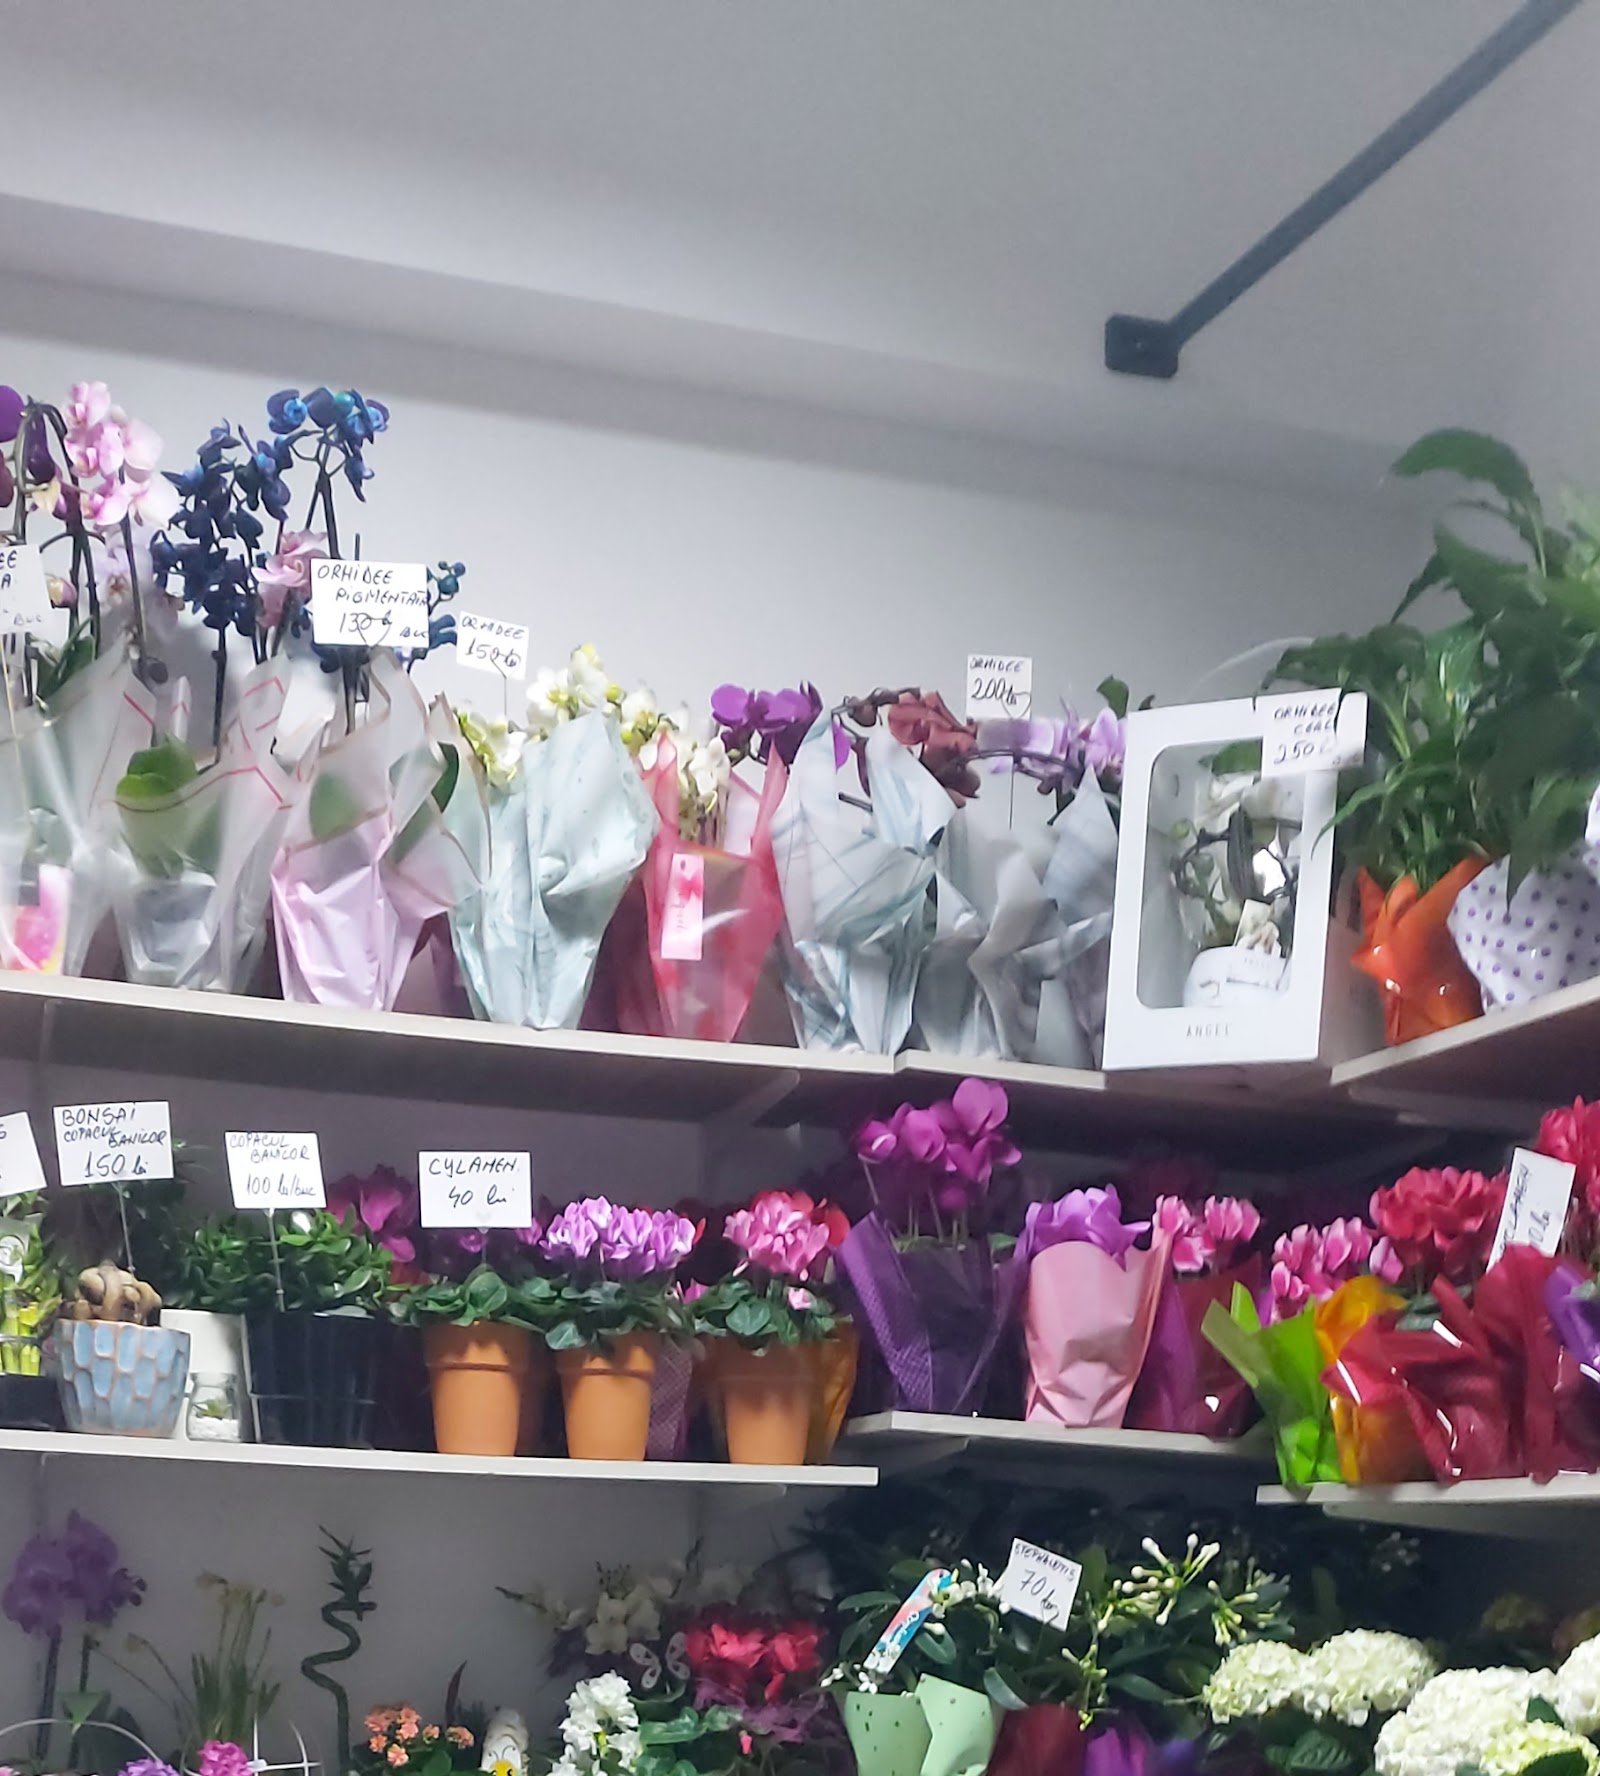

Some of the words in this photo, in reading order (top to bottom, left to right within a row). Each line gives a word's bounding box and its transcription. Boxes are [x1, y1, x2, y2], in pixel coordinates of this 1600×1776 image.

[339, 612, 372, 634] 130
[465, 637, 501, 660] 150
[971, 677, 1006, 700] 200
[1273, 740, 1315, 764] 250
[1185, 1022, 1231, 1037] ANGEL
[230, 1132, 290, 1148] COPACUL
[84, 1151, 126, 1178] 150
[247, 1173, 271, 1195] 100
[449, 1186, 473, 1208] 40
[1020, 1569, 1047, 1596] 70
